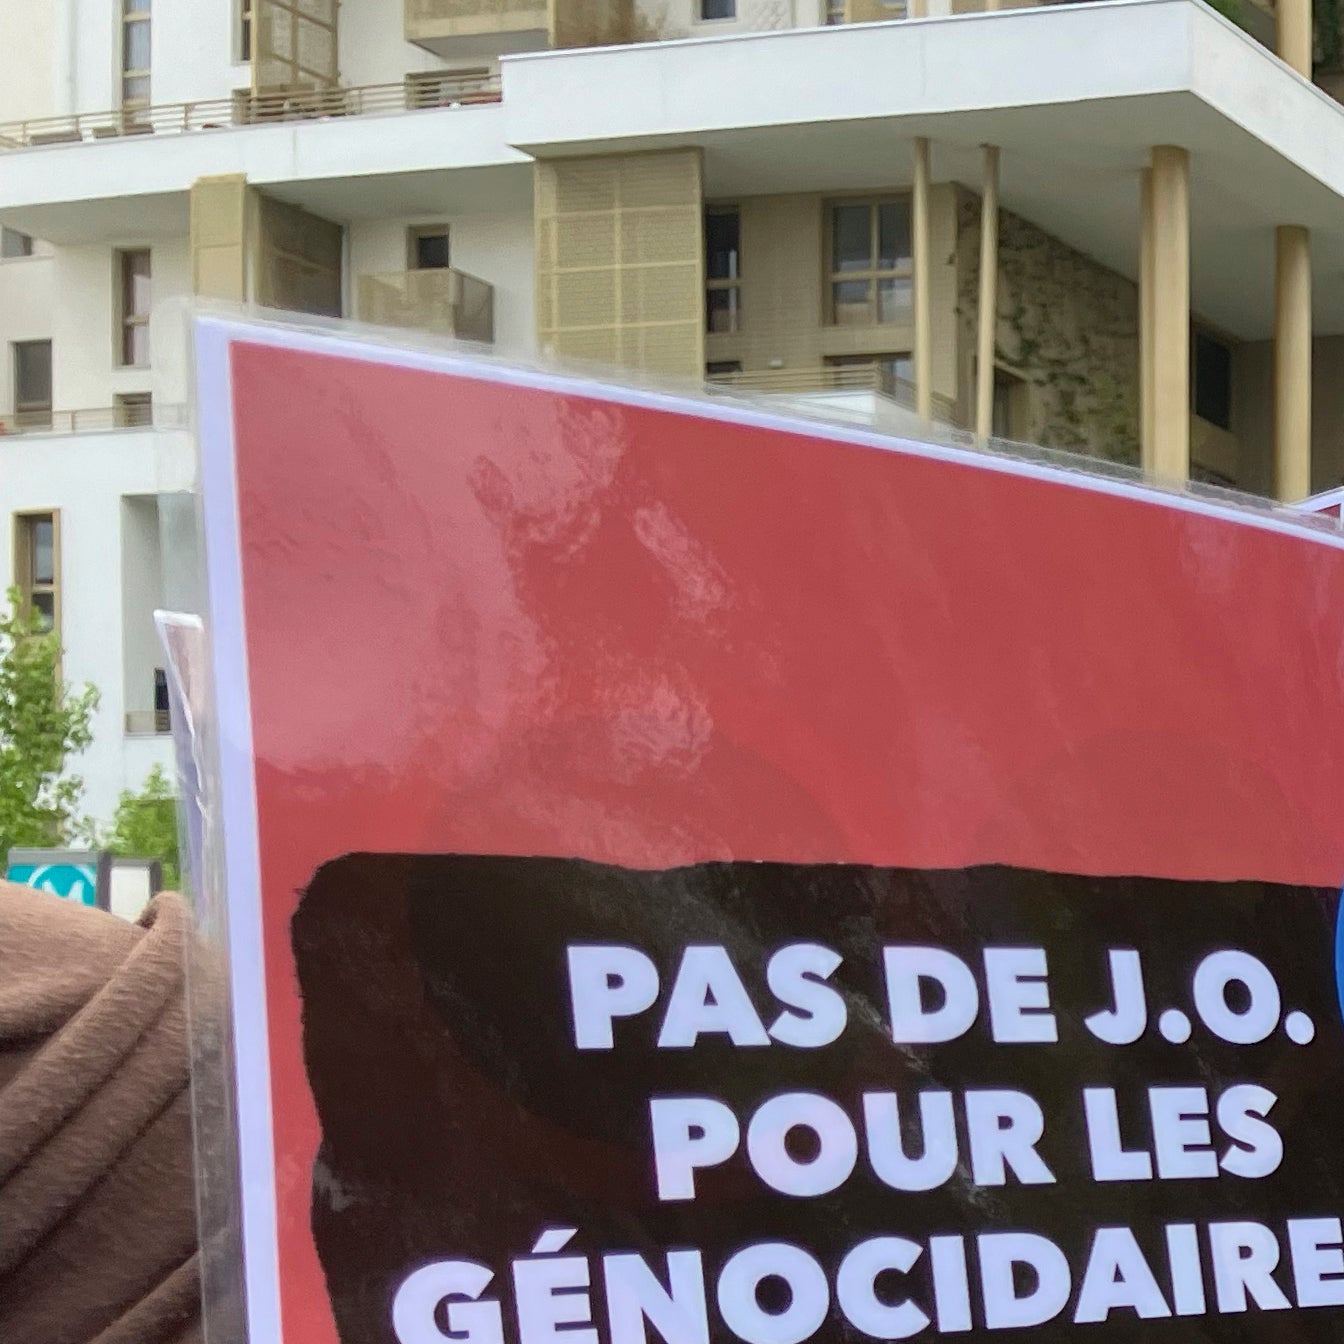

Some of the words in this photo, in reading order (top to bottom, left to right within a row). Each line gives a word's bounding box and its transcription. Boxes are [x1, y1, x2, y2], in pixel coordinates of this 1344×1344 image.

[567, 943, 849, 1050] PAS
[884, 946, 1058, 1044] DE
[1085, 948, 1315, 1045] J.O.
[649, 1088, 1056, 1200] POUR
[1083, 1083, 1283, 1181] LES
